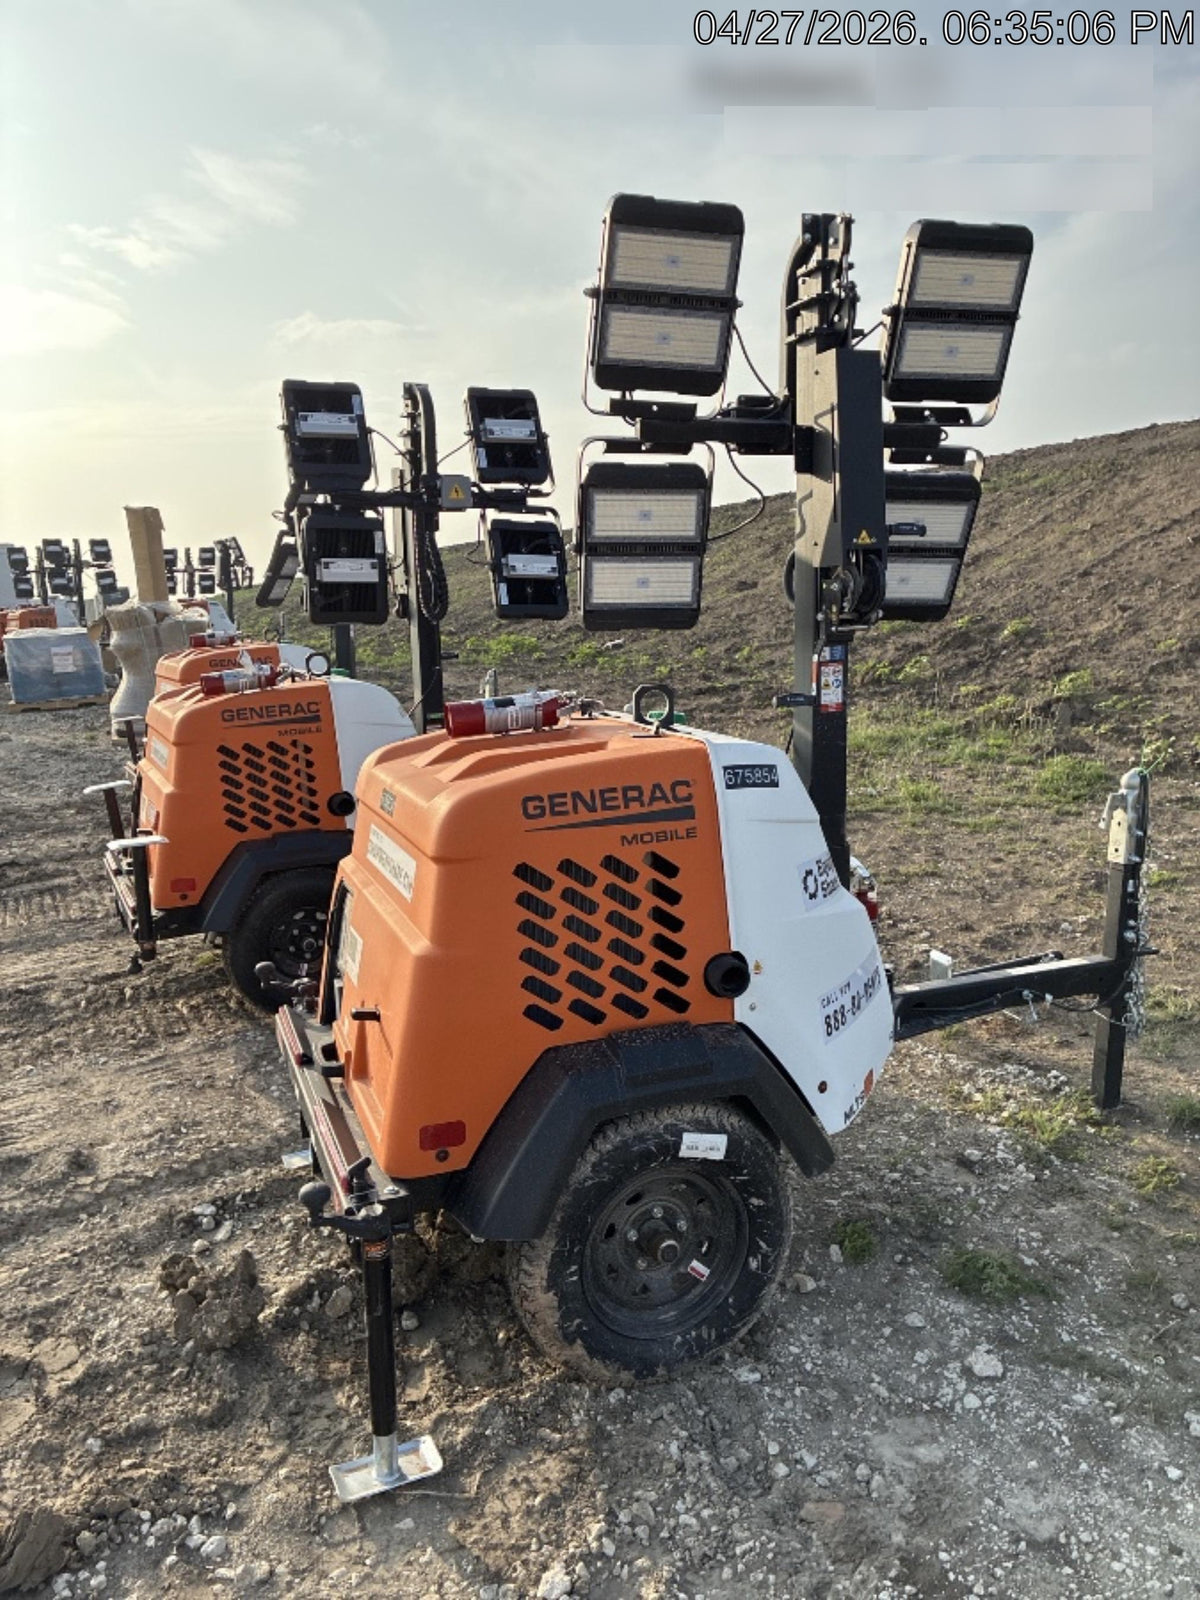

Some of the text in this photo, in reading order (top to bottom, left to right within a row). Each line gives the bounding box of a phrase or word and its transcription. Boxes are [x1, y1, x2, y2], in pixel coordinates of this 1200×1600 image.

[208, 656, 273, 669] GENAC
[221, 701, 320, 723] GENERAC
[725, 767, 778, 785] 675854
[521, 779, 694, 820] GENERAC
[620, 827, 697, 846] MOBILE
